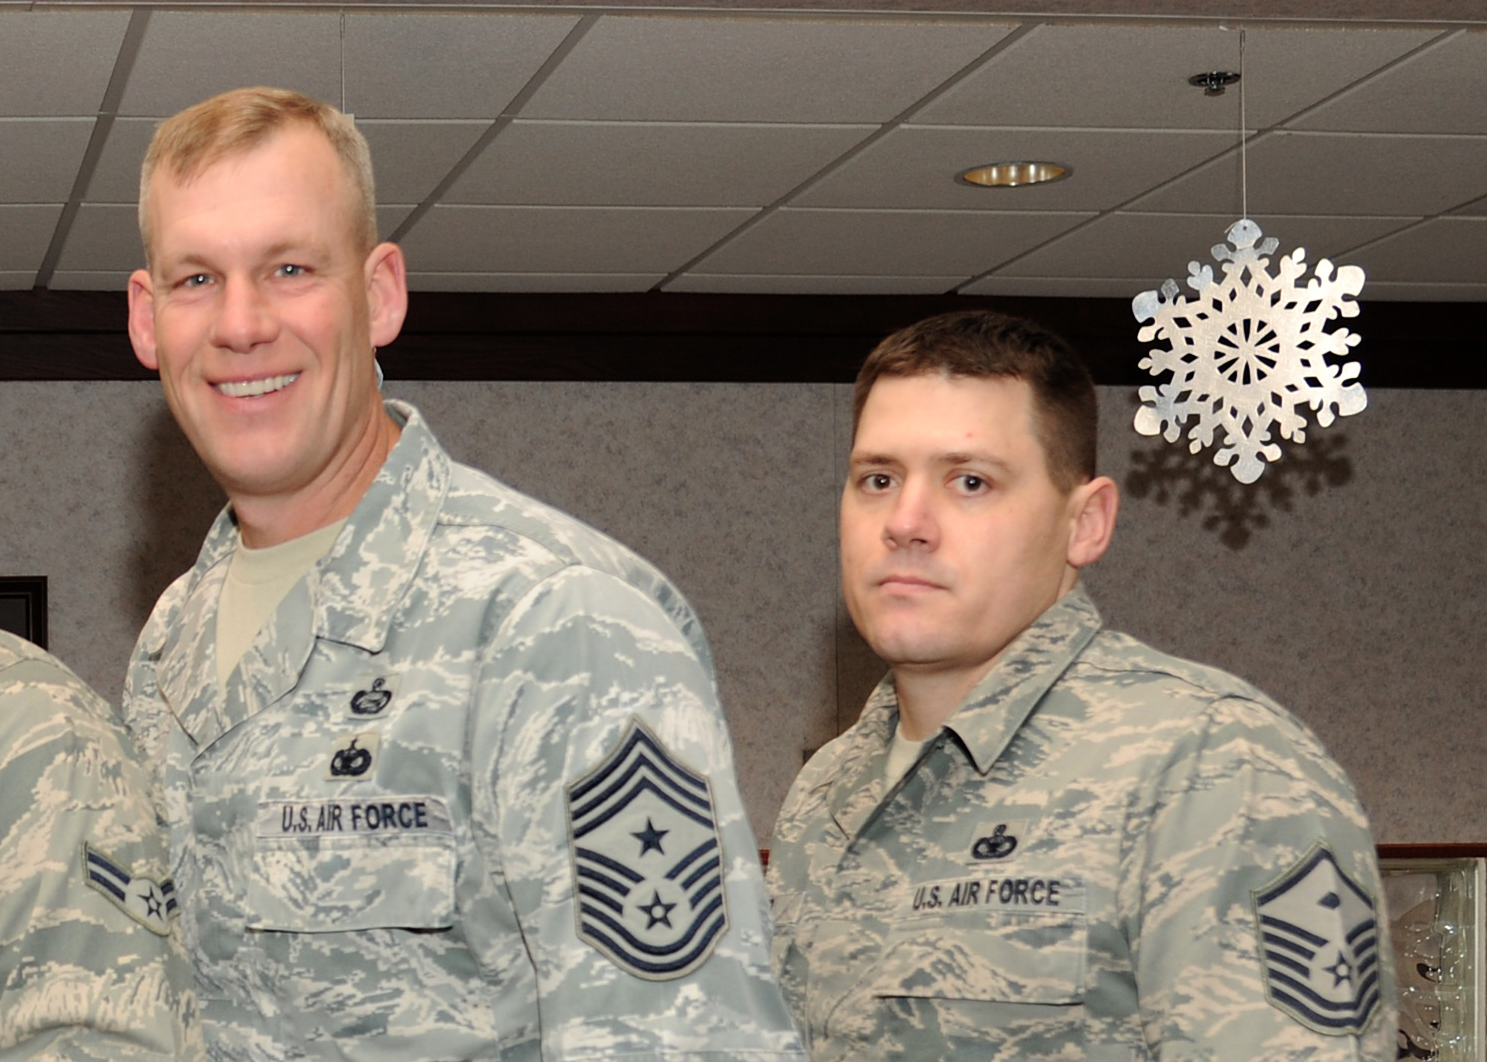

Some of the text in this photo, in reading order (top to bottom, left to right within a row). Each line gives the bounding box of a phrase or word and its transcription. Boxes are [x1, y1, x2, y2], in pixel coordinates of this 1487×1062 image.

[282, 802, 428, 832] U.S. AIR FORCE
[913, 879, 1061, 910] U.S. AIR FORCE
